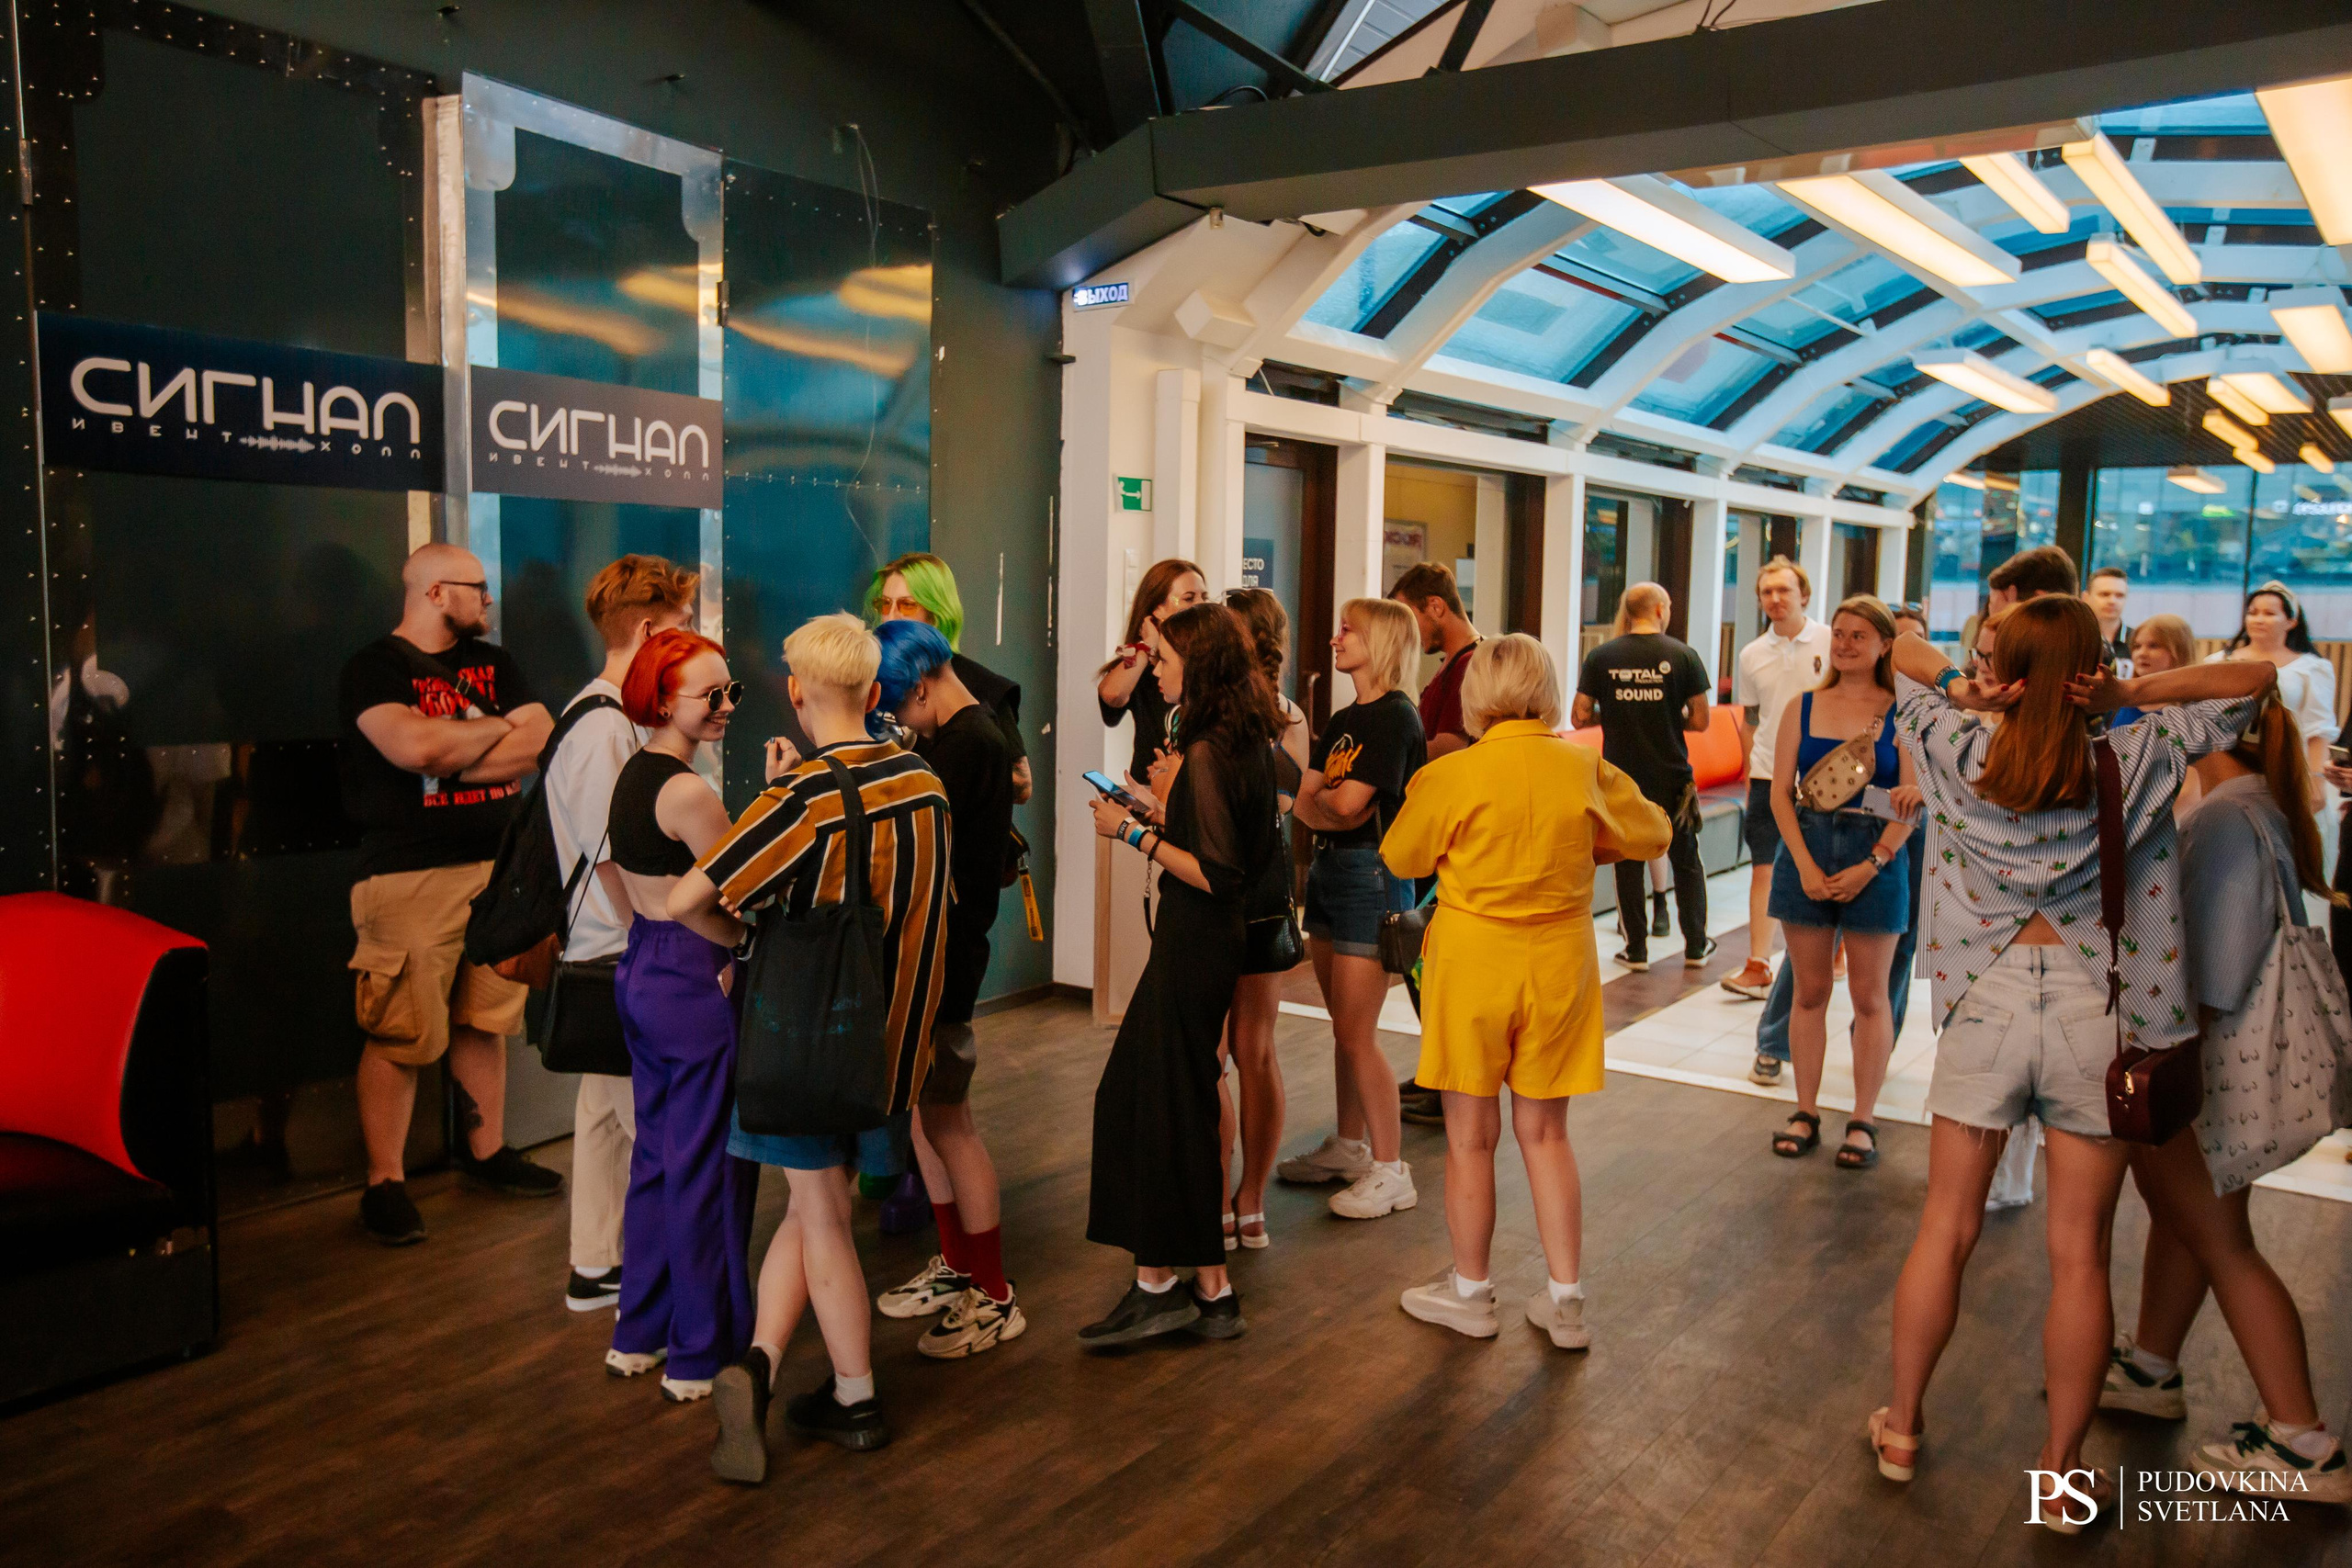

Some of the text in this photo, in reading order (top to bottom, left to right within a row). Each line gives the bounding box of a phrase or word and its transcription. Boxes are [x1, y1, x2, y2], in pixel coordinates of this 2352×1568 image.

[1075, 285, 1128, 306] ВЫХОД
[71, 356, 420, 444] СИГНАЛ
[489, 400, 709, 468] СИГНАЛ
[321, 441, 421, 459] ХОЛЛ
[1608, 669, 1663, 681] TOTAL
[1615, 688, 1664, 701] SOUND
